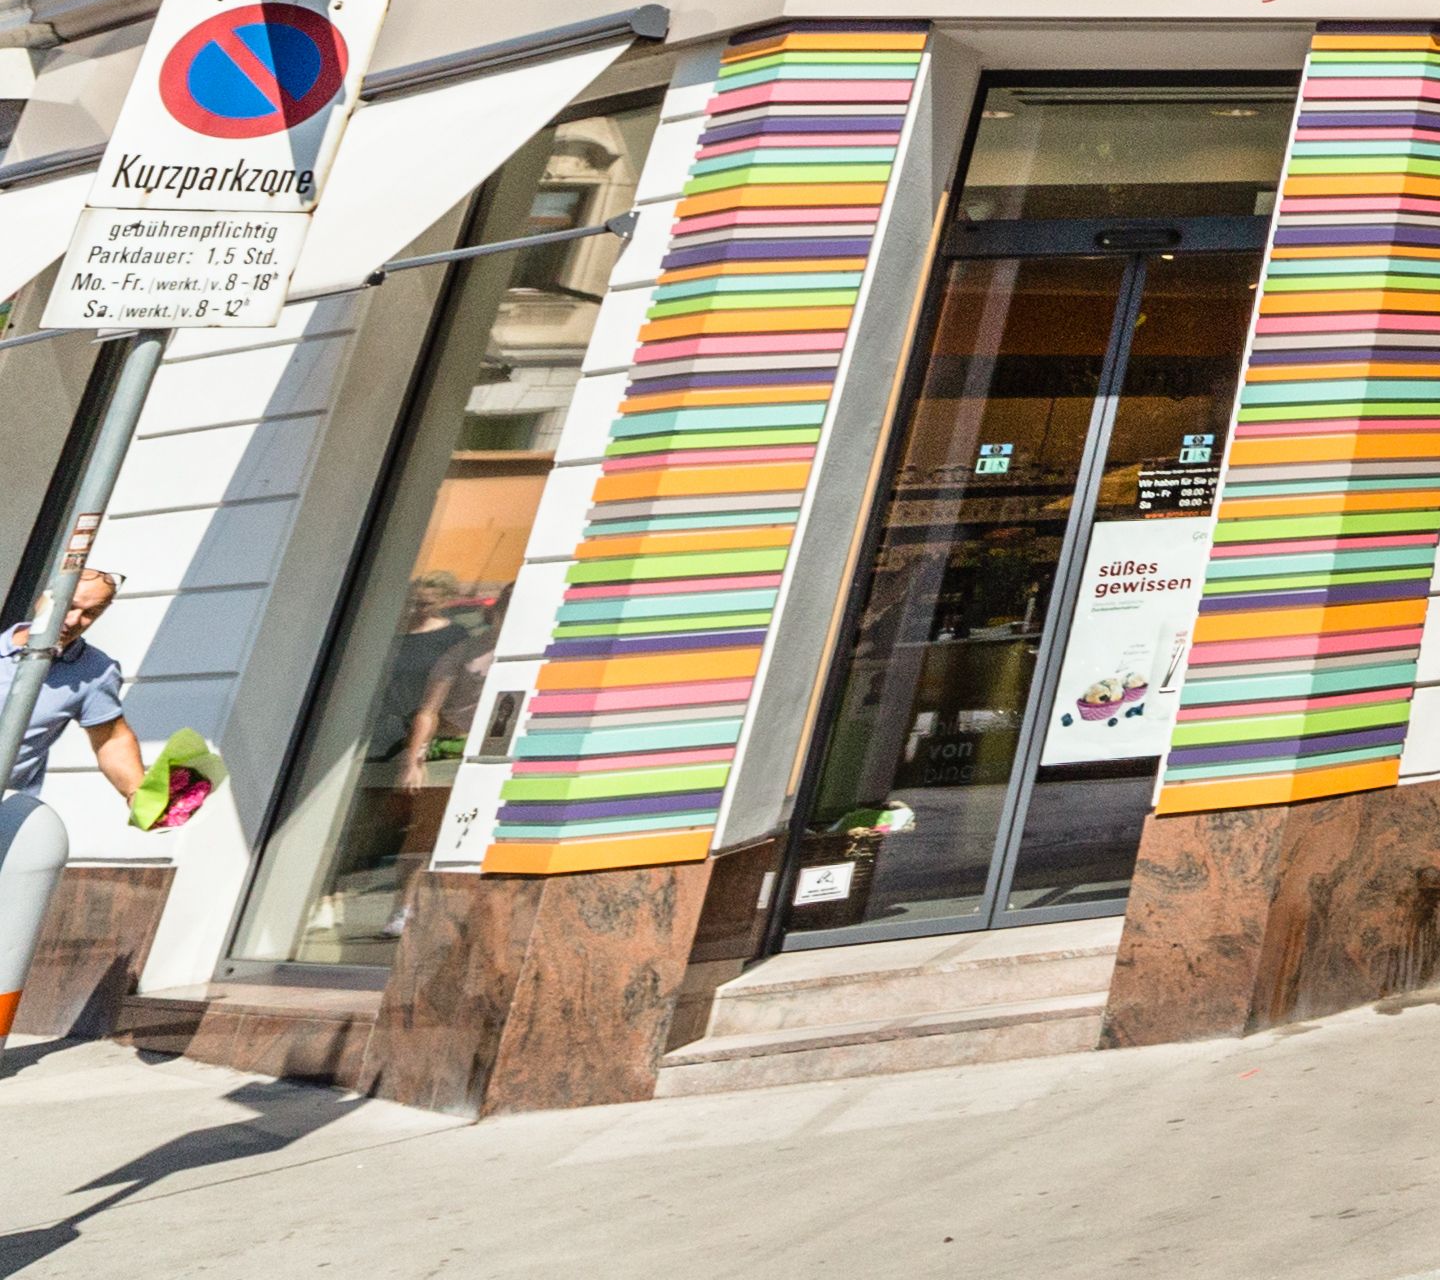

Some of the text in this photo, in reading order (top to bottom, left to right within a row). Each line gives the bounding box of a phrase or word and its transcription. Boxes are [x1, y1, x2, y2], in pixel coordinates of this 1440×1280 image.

[111, 153, 315, 199] Kurzparkzone
[107, 220, 279, 243] gebührenpflichtig
[86, 245, 279, 268] Parkdauer: 1,5 Std.
[83, 299, 114, 319] Sa.
[1138, 479, 1153, 488] Wir
[1153, 478, 1180, 488] haben
[1193, 476, 1207, 485] Sie
[1098, 560, 1159, 578] süßes
[1094, 577, 1192, 599] gewissen
